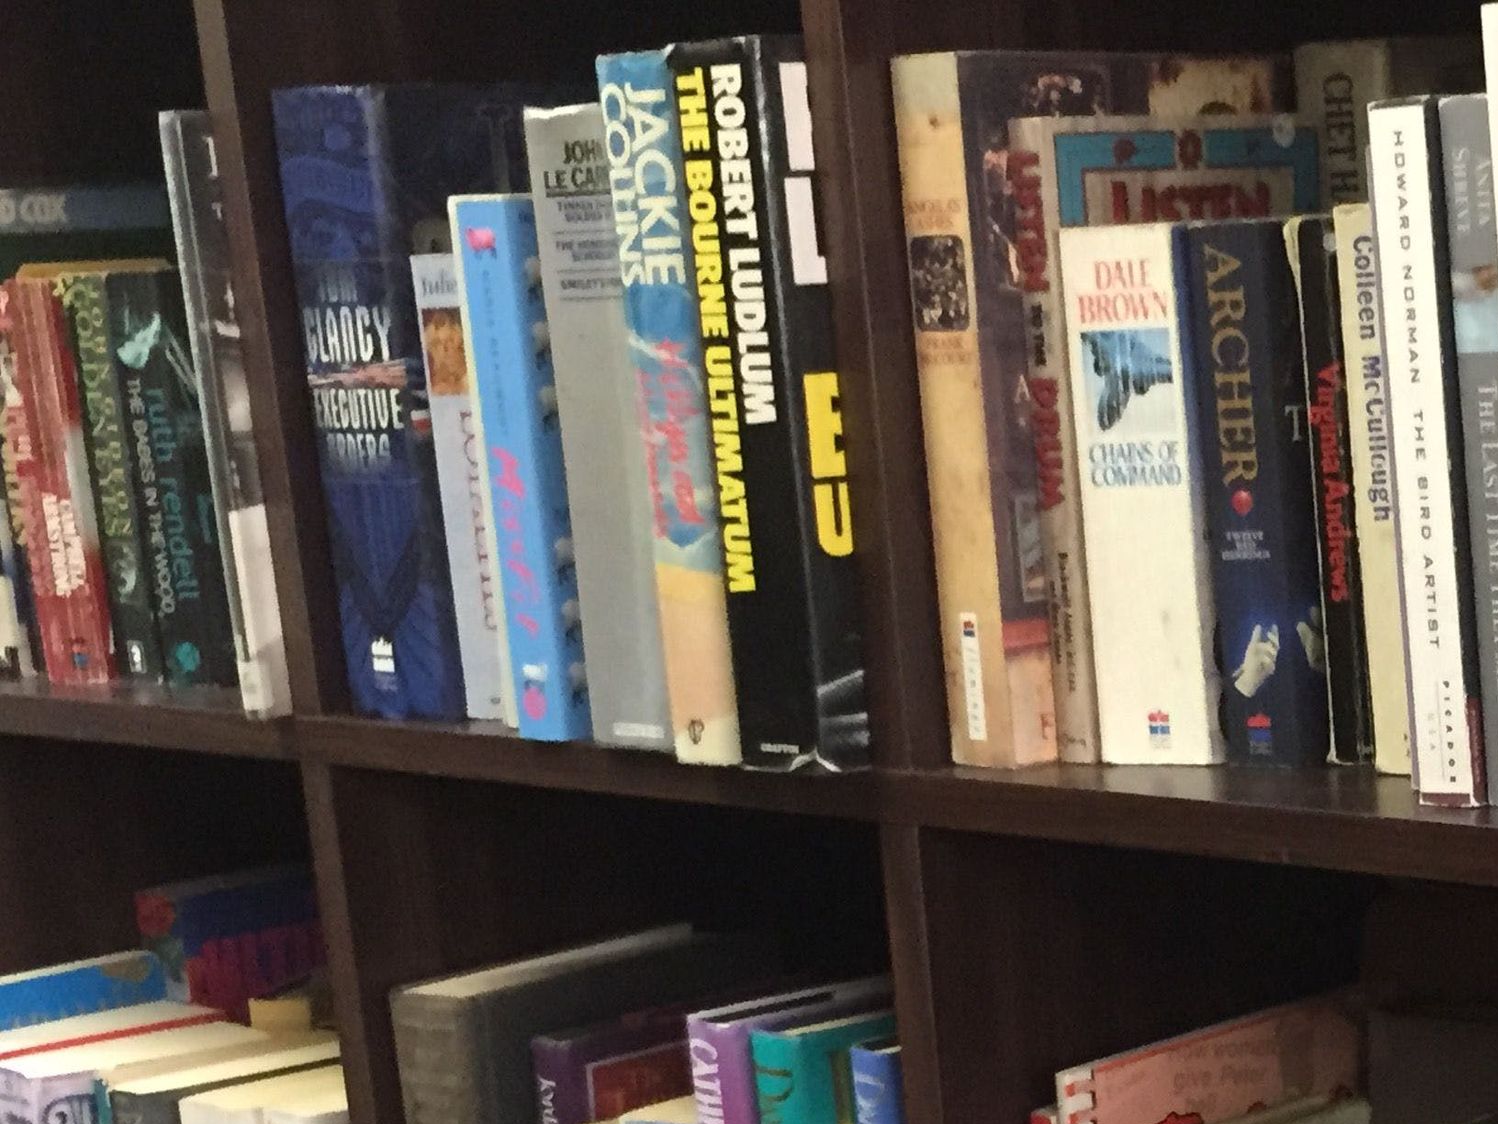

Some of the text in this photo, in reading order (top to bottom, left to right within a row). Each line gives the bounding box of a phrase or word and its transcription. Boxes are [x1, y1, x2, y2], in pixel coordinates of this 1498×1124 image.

[543, 168, 568, 190] LE
[600, 82, 645, 288] COLLINS
[625, 82, 687, 285] JACKIE
[710, 63, 777, 425] ROBERT LUDLUM
[1093, 259, 1151, 290] DALE
[1352, 236, 1376, 341] Colleen
[303, 306, 393, 364] CLANCY
[676, 66, 756, 593] THE BOURNE ULTIMATUM
[1077, 291, 1168, 324] BROWN
[313, 388, 405, 429] EXECUTIVE
[1203, 242, 1259, 488] ARCHER
[1391, 130, 1440, 649] HOWARD NORMAN THE BIRD ARTIST
[1478, 379, 1498, 434] THE
[146, 388, 199, 600] ruth rendell
[1089, 440, 1181, 464] CHAINS OF
[1092, 463, 1182, 488] COMMAND
[1308, 362, 1351, 601] Virginia Andrews
[1441, 680, 1457, 783] PICADOR
